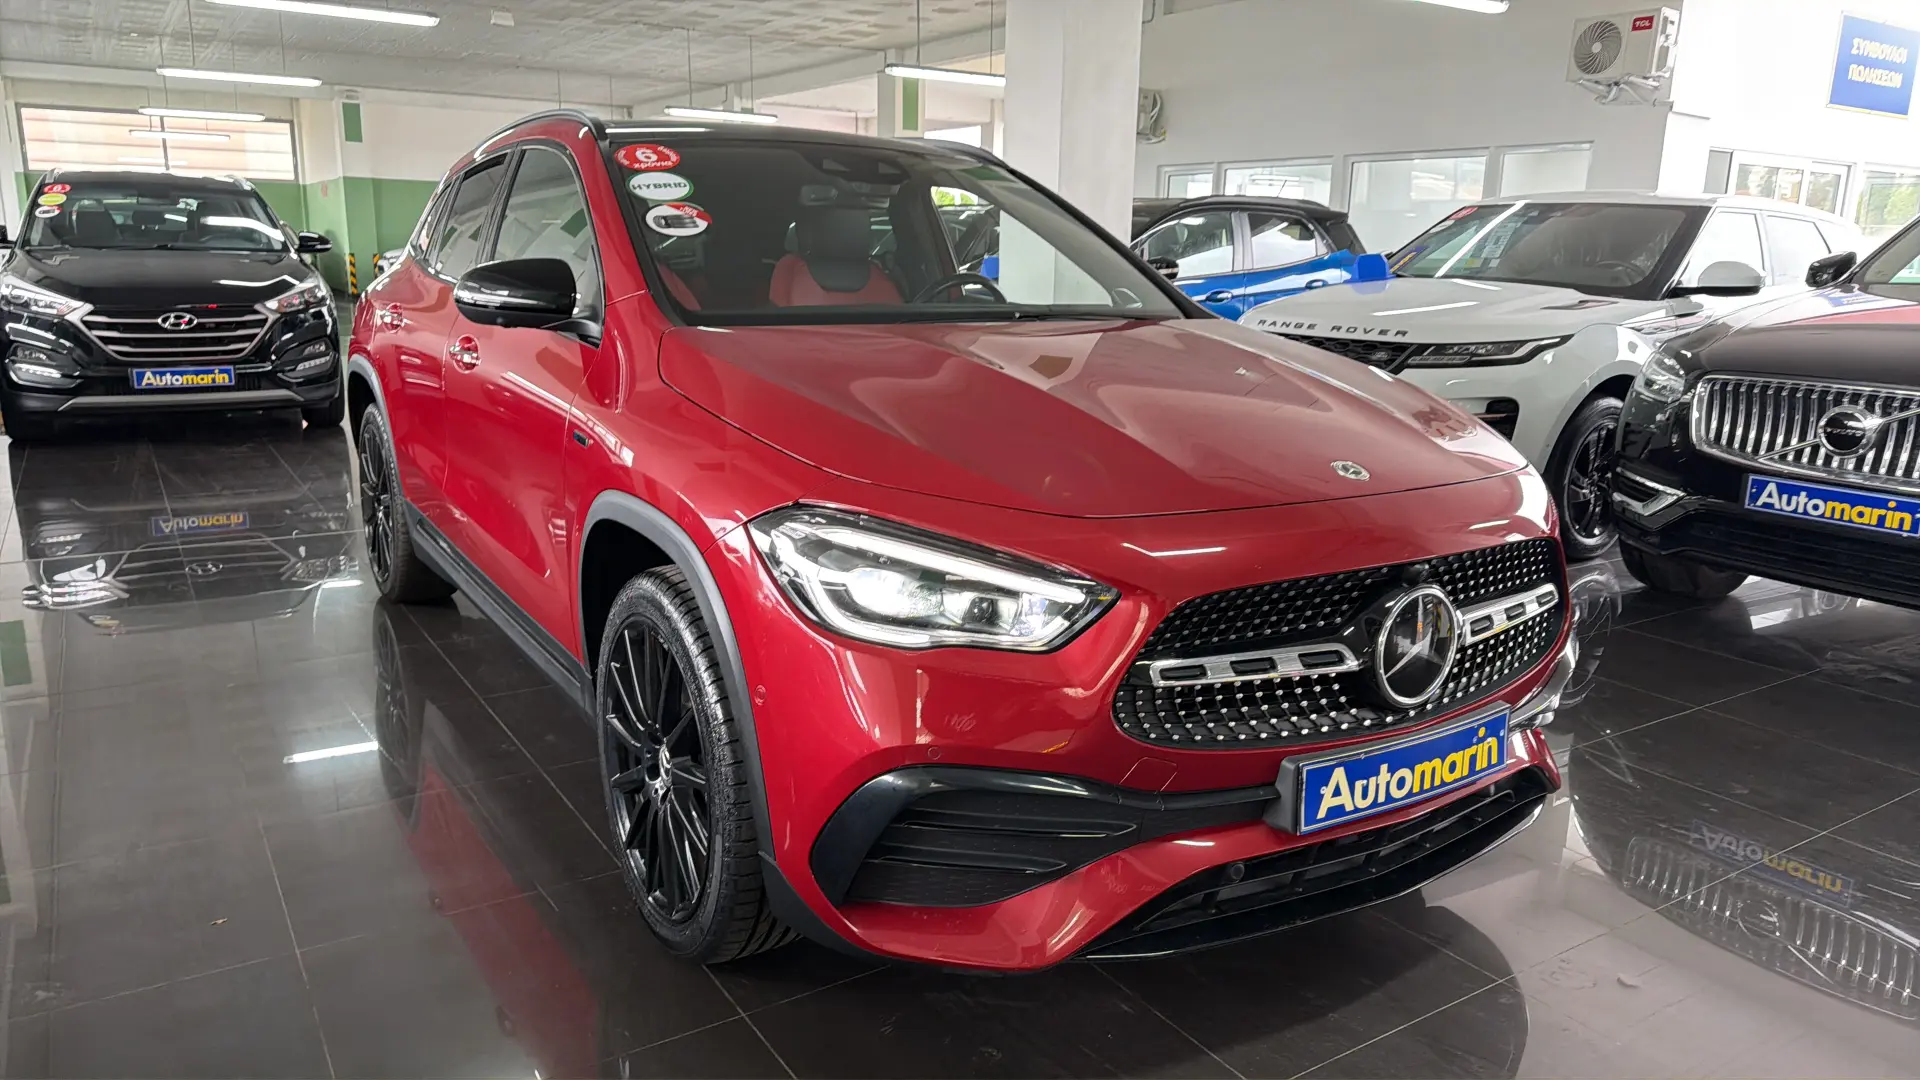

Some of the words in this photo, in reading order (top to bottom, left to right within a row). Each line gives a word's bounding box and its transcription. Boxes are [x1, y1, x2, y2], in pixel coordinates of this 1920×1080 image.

[1851, 37, 1908, 64] ΣΥΜΒΟΥΛΟΙ
[635, 148, 658, 162] 6
[631, 182, 688, 190] HYBRID
[1257, 319, 1317, 330] RANGE
[1330, 325, 1409, 337] ROVER
[141, 369, 229, 386] Automarin
[1756, 482, 1912, 531] Automarin
[1316, 727, 1498, 820] Automarin
